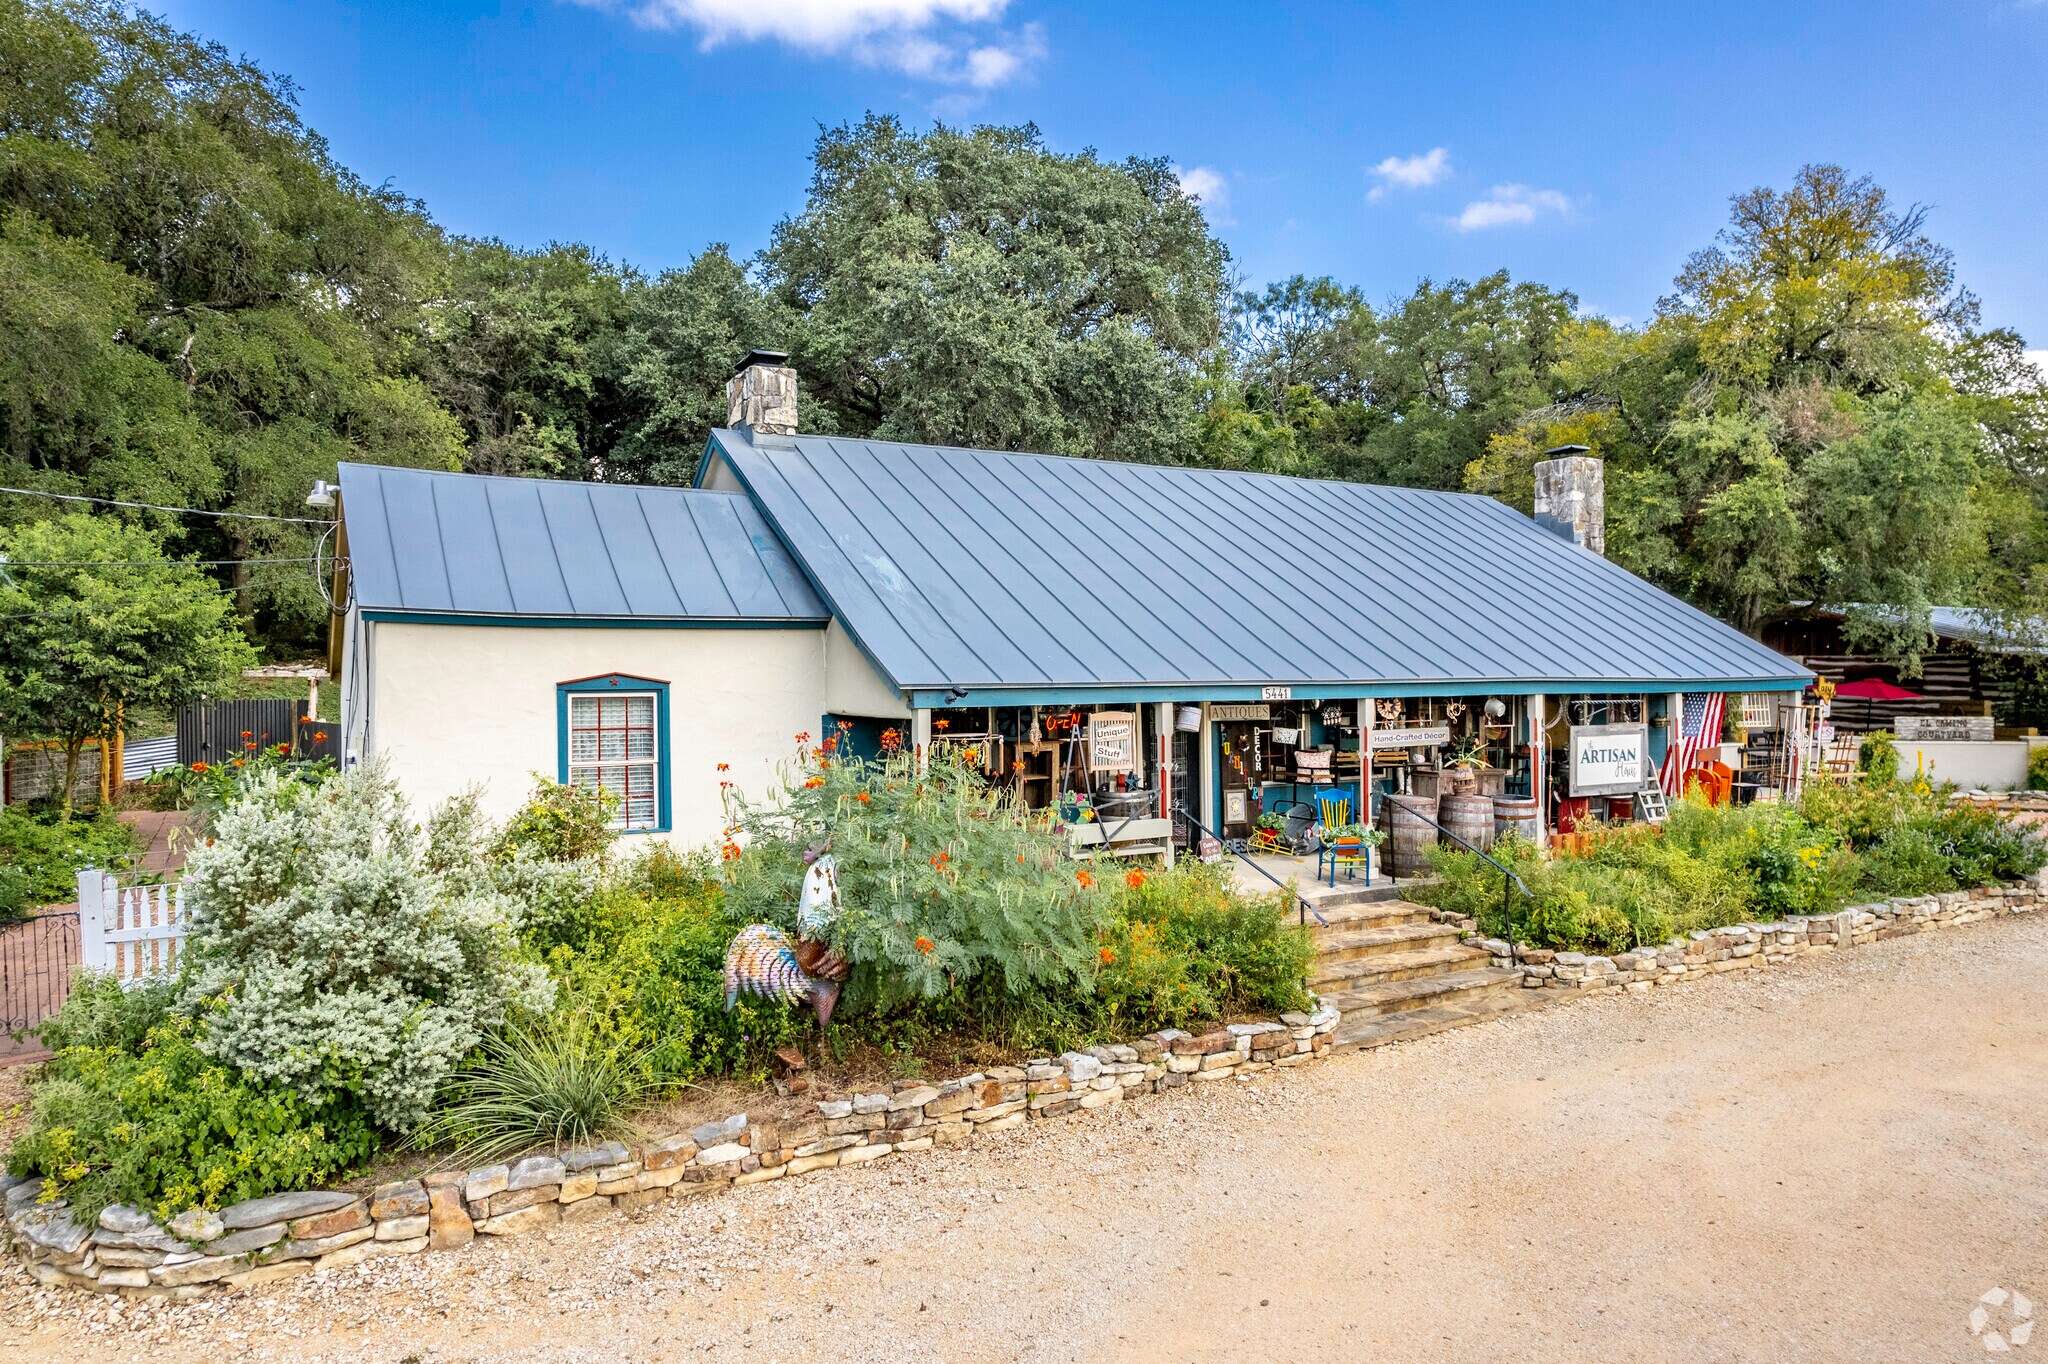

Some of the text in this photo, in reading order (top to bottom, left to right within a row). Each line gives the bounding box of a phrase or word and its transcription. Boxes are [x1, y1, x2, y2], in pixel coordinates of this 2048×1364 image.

[1265, 688, 1288, 699] 5441
[1212, 706, 1269, 719] ANTIQUES
[1920, 719, 1968, 728] EL CAMINO
[1097, 727, 1129, 738] Unique
[1374, 733, 1422, 742] Hand-Crafted
[1917, 730, 1971, 739] COURTYARD
[1097, 747, 1120, 758] Stuff
[1254, 726, 1262, 771] DECOR
[1580, 747, 1636, 764] ARTISAN
